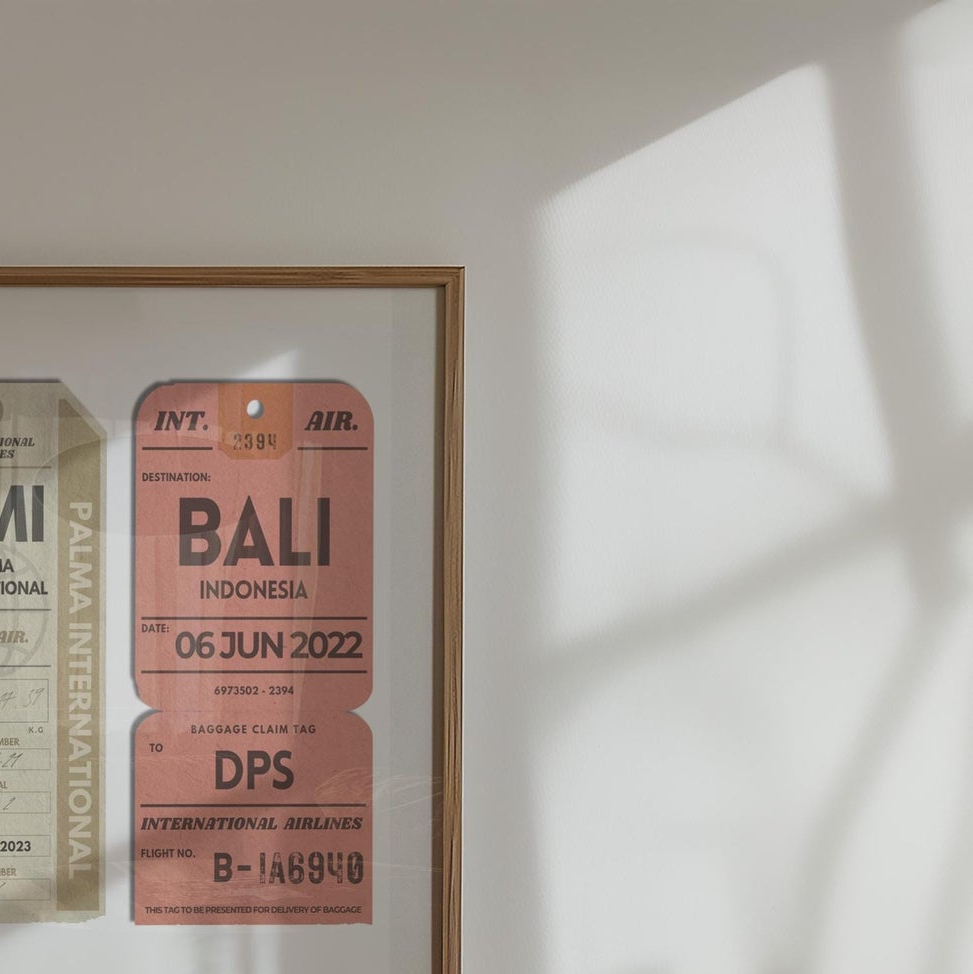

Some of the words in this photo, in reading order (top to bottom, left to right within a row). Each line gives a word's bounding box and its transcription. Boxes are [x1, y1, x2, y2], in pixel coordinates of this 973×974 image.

[154, 410, 209, 431] INT.
[304, 410, 359, 431] AIR.
[233, 433, 277, 450] 2394
[142, 473, 211, 482] DESTINATION:
[179, 495, 331, 566] BALI
[68, 502, 93, 614] PALMA
[200, 580, 308, 599] INDONESIA
[141, 623, 169, 633] DATE:
[175, 631, 215, 659] 06
[219, 631, 284, 659] JUN
[290, 631, 363, 659] 2022
[214, 686, 259, 695] 6973502
[268, 686, 294, 695] 2394
[191, 725, 247, 734] BAGGAGE
[252, 725, 288, 734] CLAIM
[293, 725, 316, 734] TAG
[68, 622, 92, 880] INTERNATIONAL
[149, 743, 163, 752] TO
[215, 750, 294, 790] DPS
[140, 817, 277, 830] INTERNATIONAL
[284, 817, 363, 830] AIRLINES
[0, 841, 31, 852] 2023
[141, 849, 174, 858] FLIGHT
[177, 849, 196, 858] NO.
